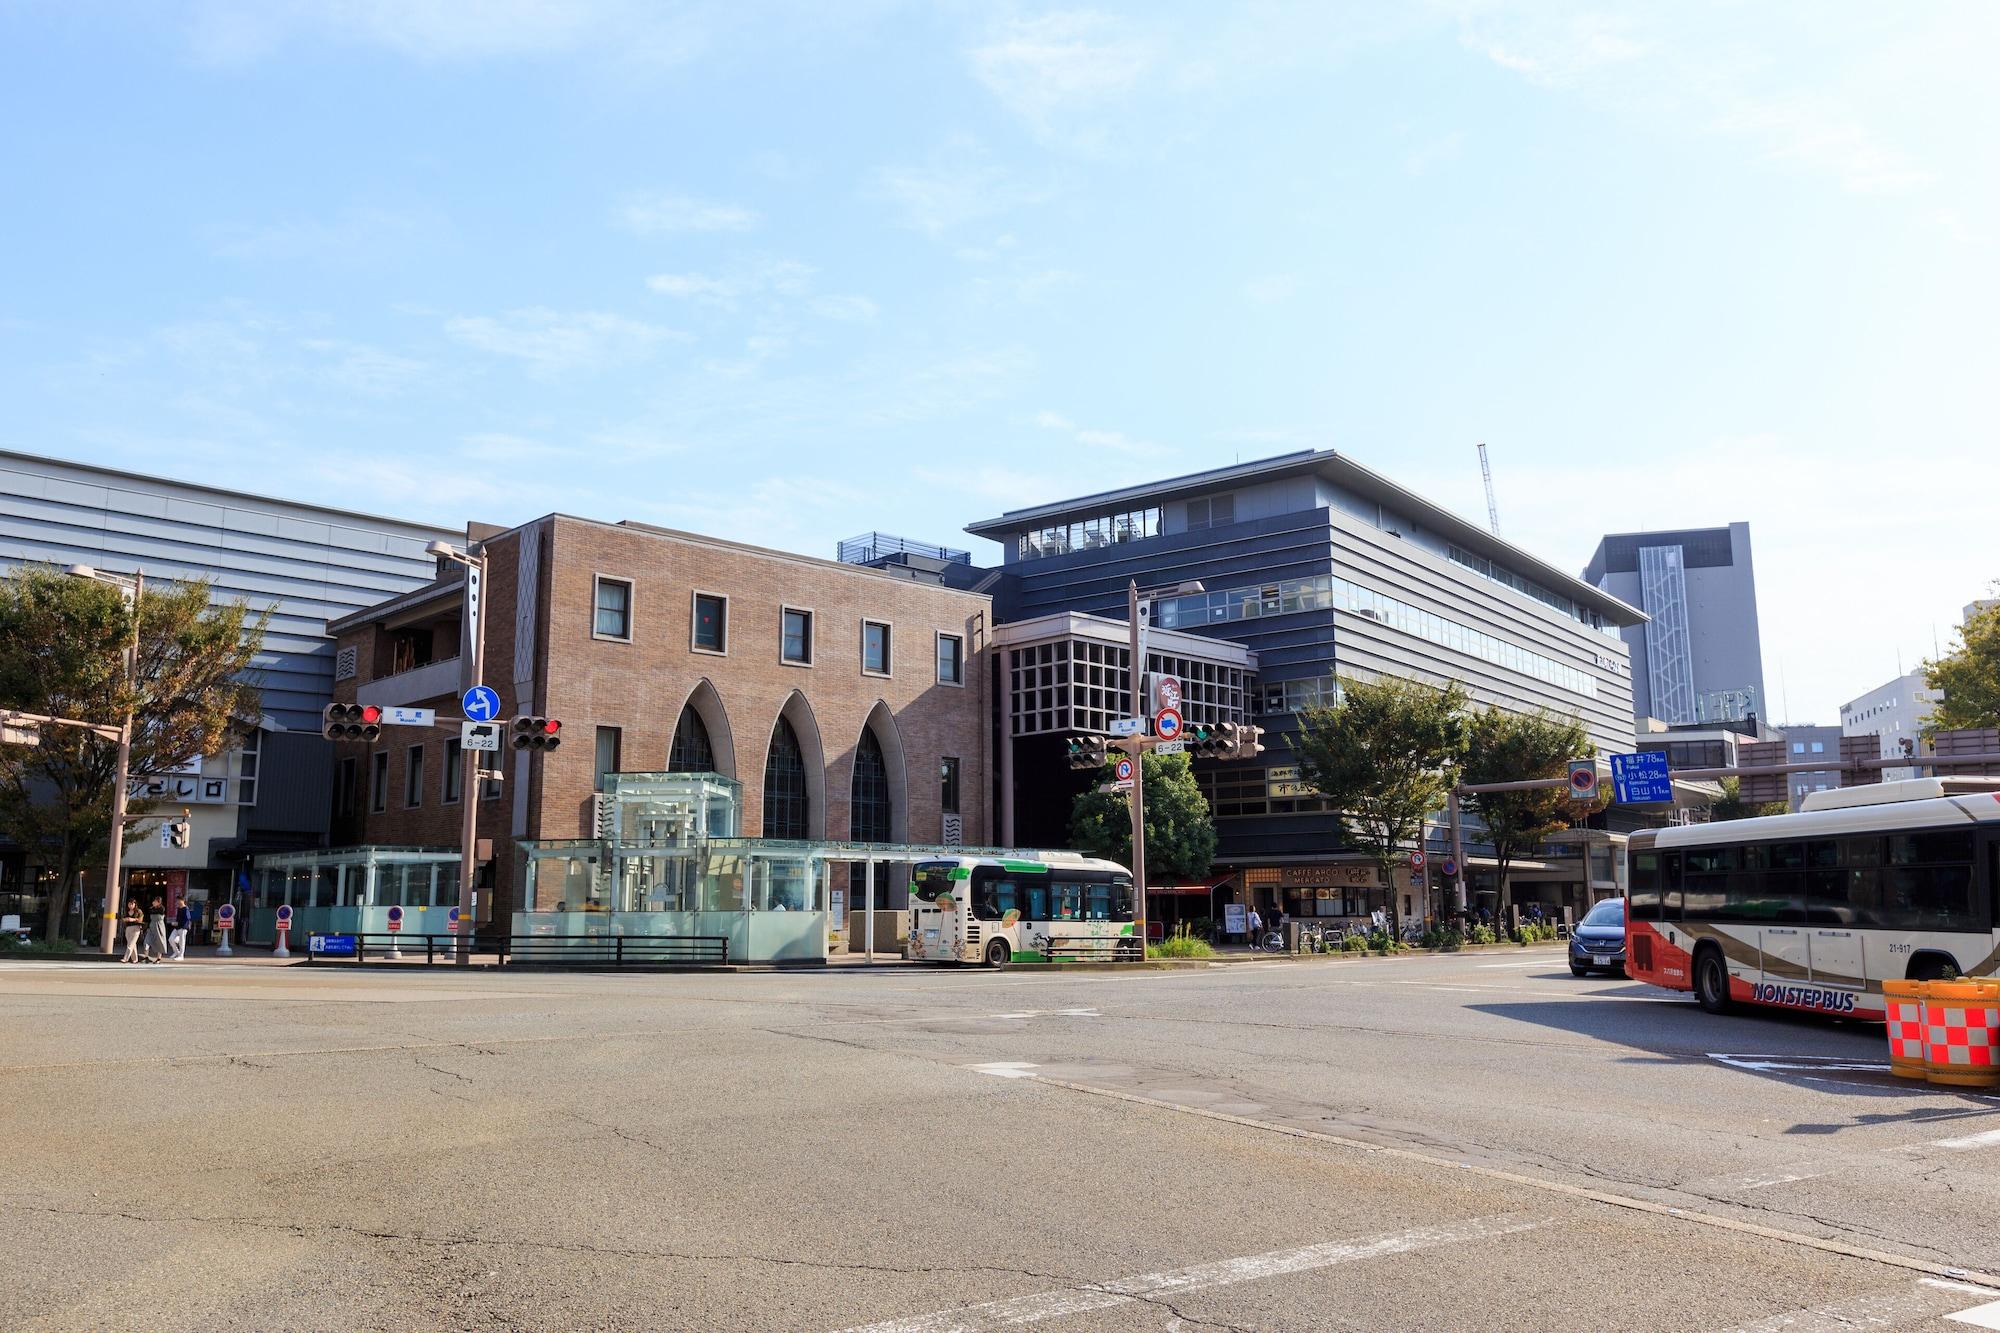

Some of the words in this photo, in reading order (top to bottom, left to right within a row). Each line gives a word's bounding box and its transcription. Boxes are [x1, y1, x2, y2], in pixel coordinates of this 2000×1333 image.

[467, 739, 493, 748] 6-22
[1158, 743, 1182, 752] 6-22
[1626, 755, 1644, 764] 福井
[1628, 771, 1648, 780] 小松
[1631, 787, 1650, 796] 白山
[1889, 943, 1911, 954] 21-917
